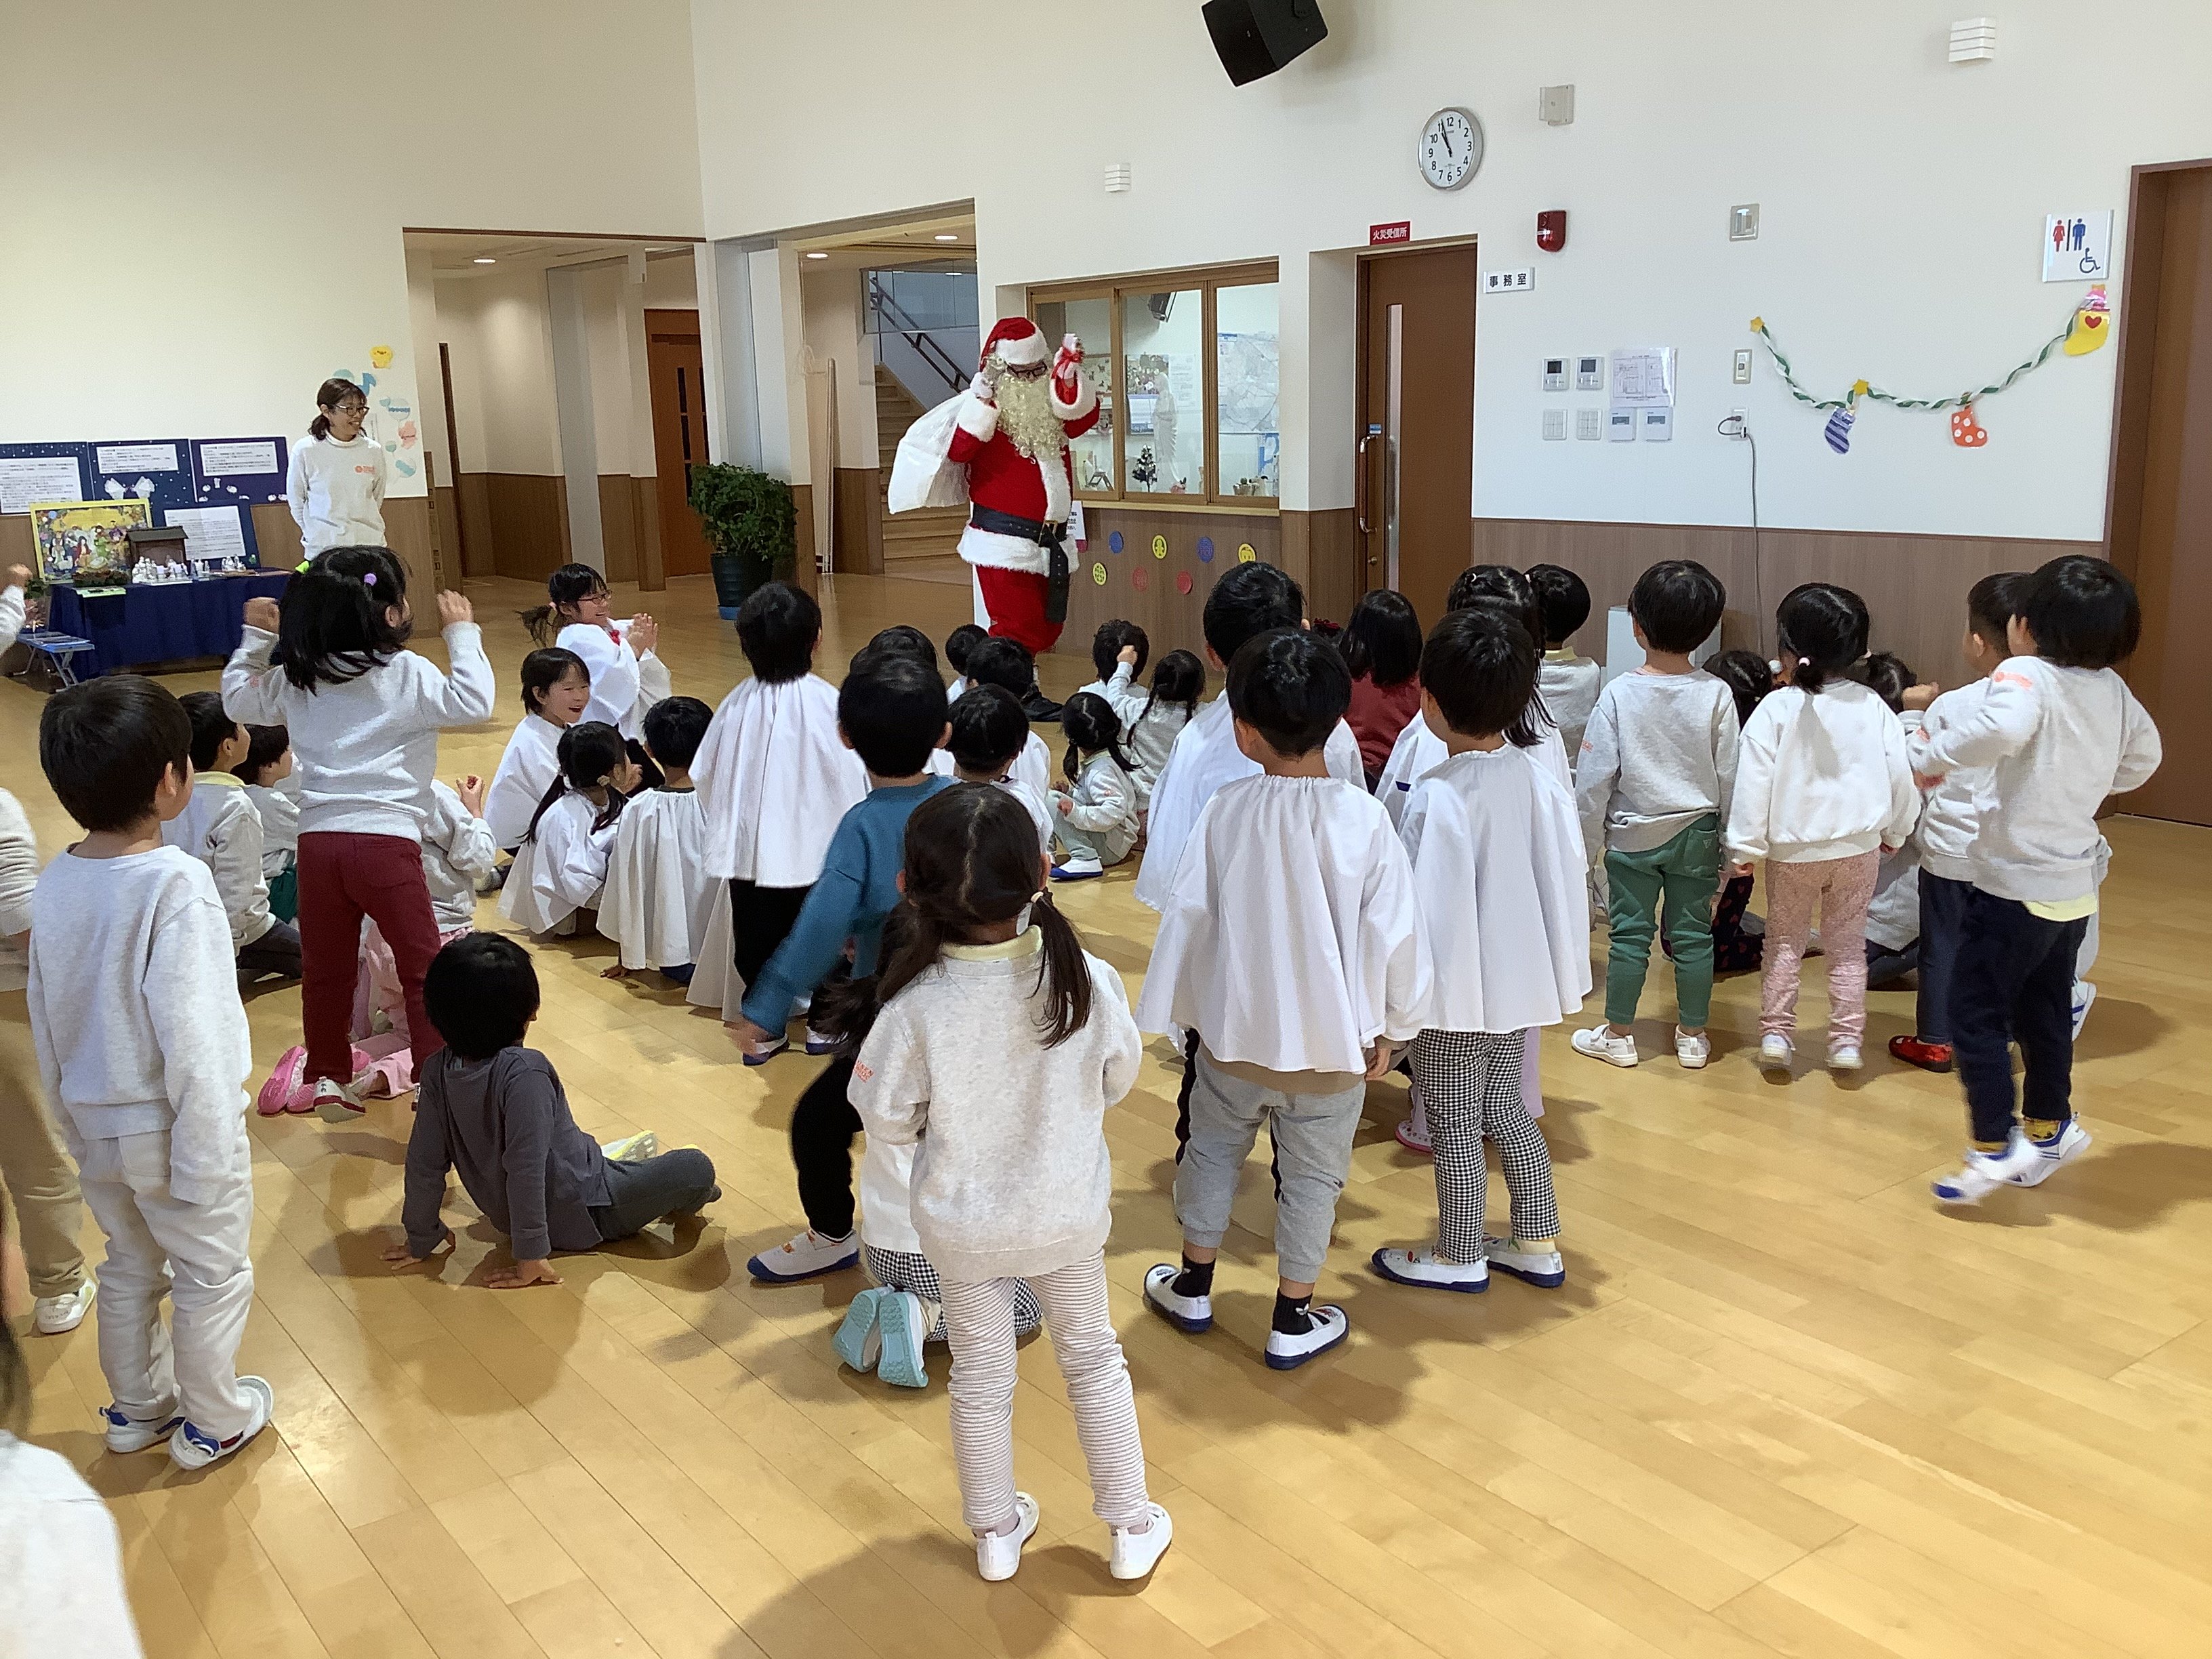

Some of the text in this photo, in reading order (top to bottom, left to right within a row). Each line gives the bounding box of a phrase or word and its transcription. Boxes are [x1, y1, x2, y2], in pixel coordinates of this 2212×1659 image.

[1447, 117, 1454, 127] 12
[1458, 119, 1461, 129] 1
[1464, 127, 1469, 138] 2
[1430, 134, 1438, 144] 10
[1467, 141, 1472, 151] 3
[1429, 148, 1433, 158] 9
[1431, 161, 1437, 170] 8
[1463, 156, 1469, 165] 4
[1439, 170, 1443, 180] 7
[1448, 171, 1452, 182] 6
[1457, 167, 1462, 177] 5
[1490, 273, 1526, 288] 事務室
